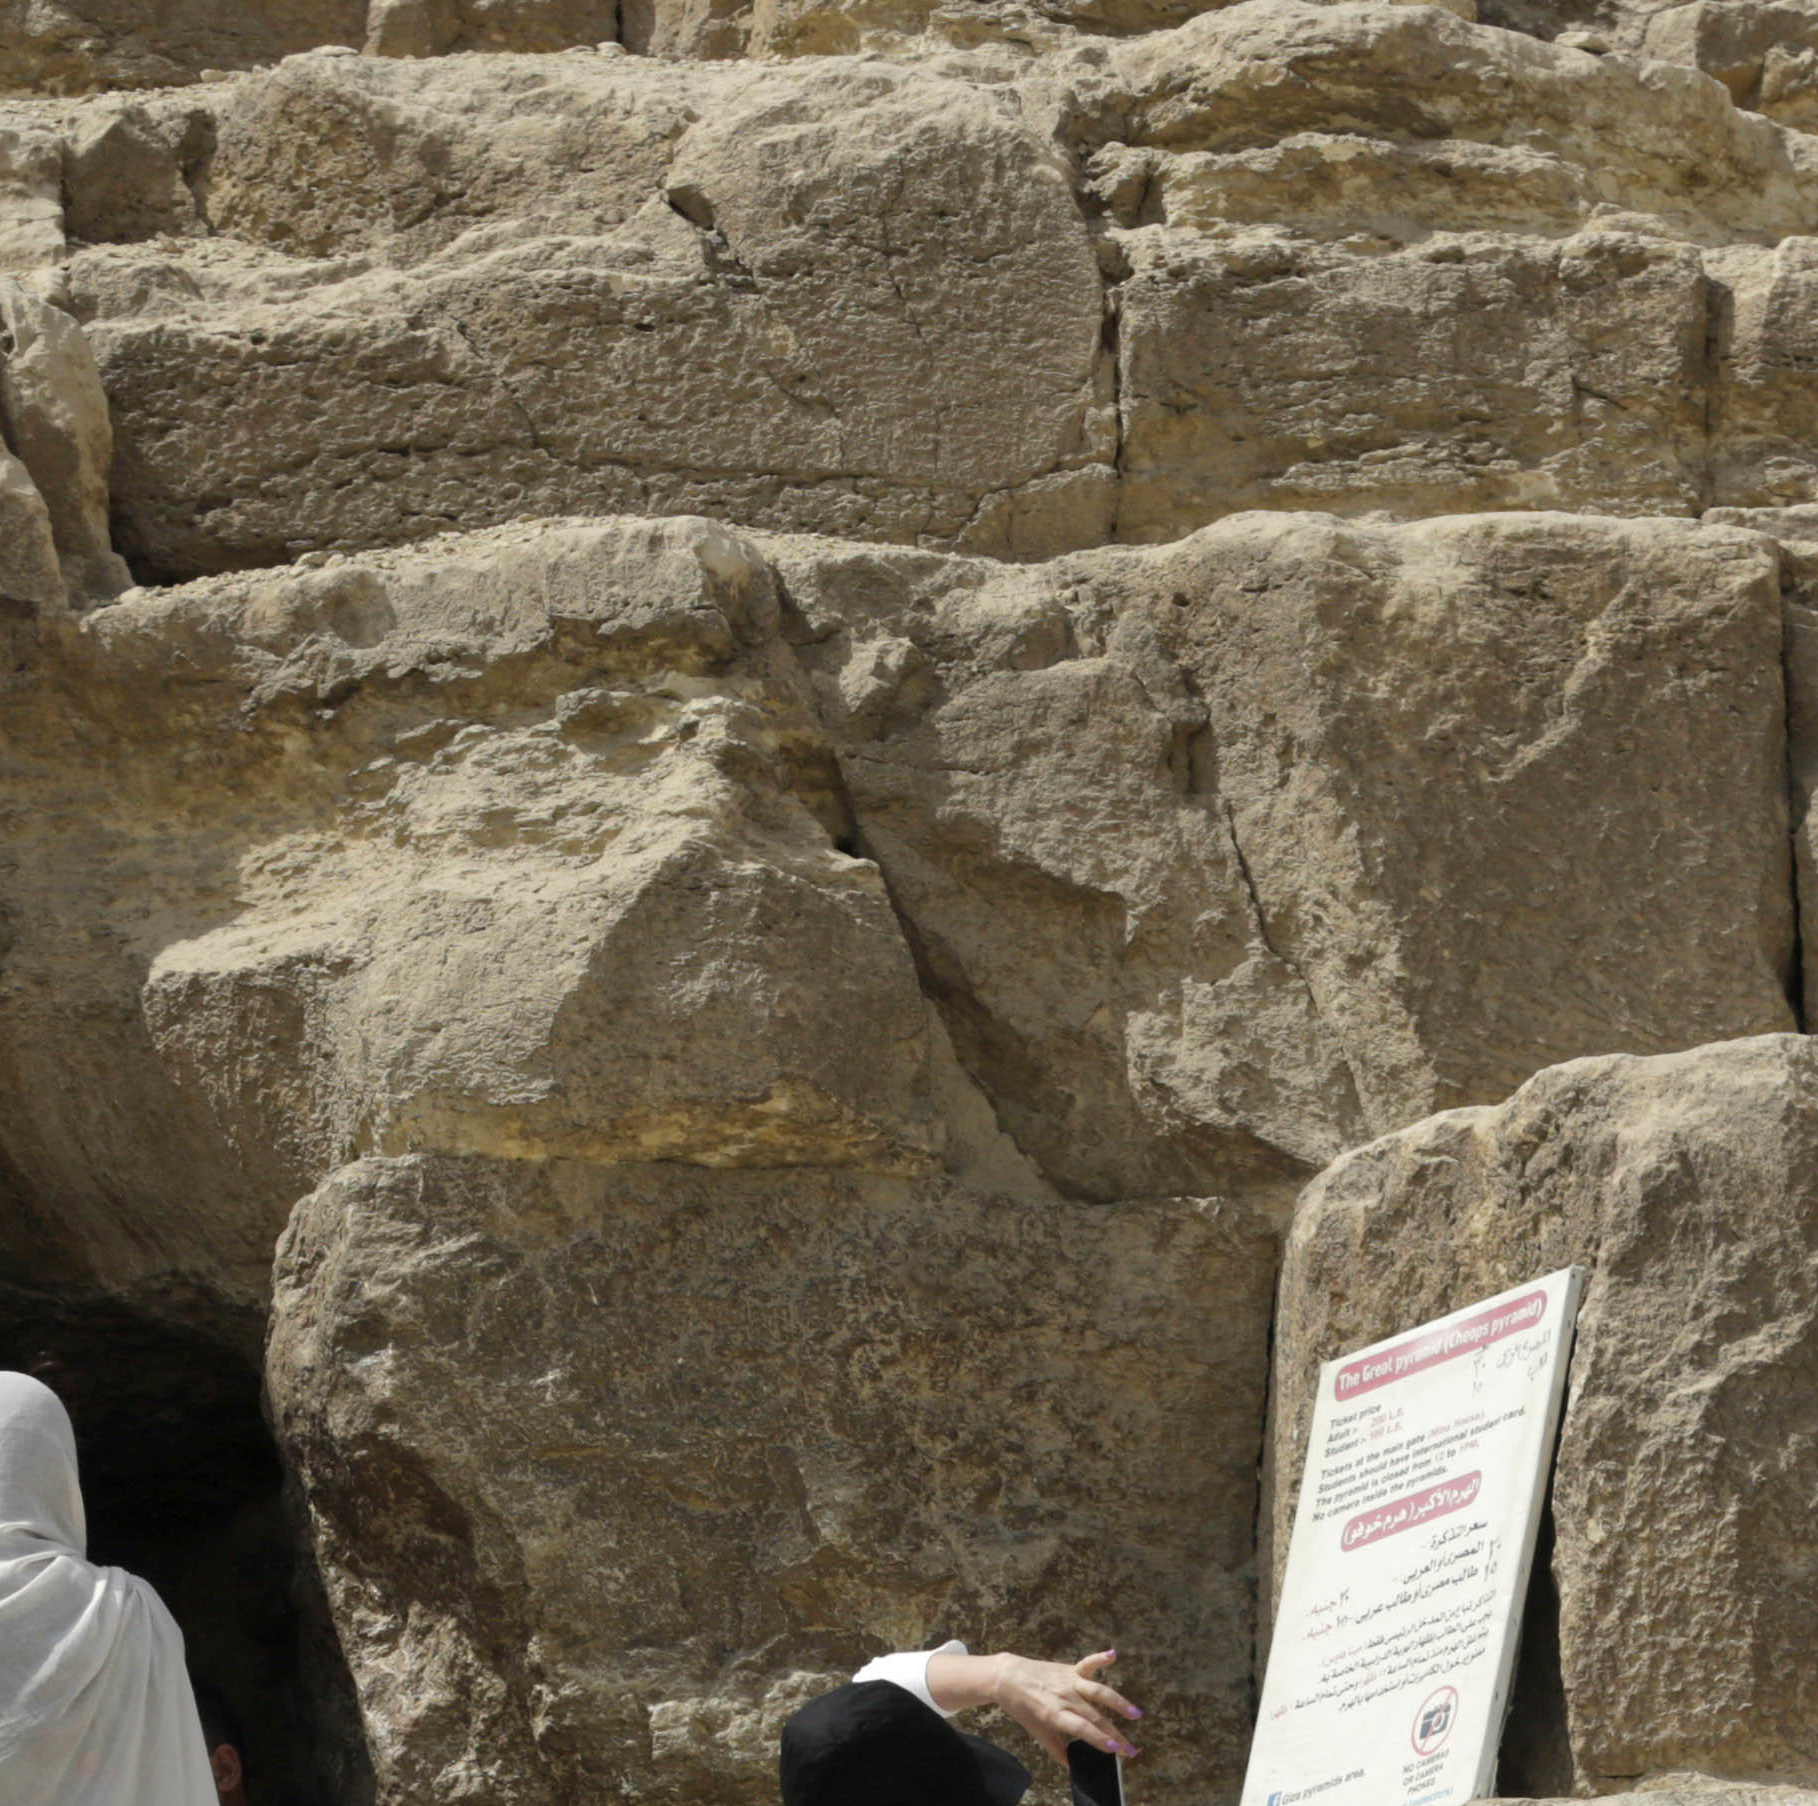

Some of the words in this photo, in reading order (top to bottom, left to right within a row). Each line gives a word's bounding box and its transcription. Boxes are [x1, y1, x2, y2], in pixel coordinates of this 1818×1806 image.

[1339, 1372, 1360, 1390] The
[1362, 1356, 1393, 1381] Great
[1443, 1323, 1489, 1353] (Cheops
[1490, 1298, 1542, 1336] pyramid)
[1330, 1412, 1358, 1429] Ticket
[1358, 1404, 1382, 1421] price
[1318, 1474, 1356, 1494] Students
[1358, 1460, 1387, 1479] should
[1389, 1454, 1409, 1467] have
[1412, 1429, 1468, 1458] international
[1470, 1416, 1502, 1436] student
[1321, 1462, 1352, 1479] Tickets
[1355, 1456, 1364, 1467] at
[1366, 1452, 1380, 1463] the
[1382, 1443, 1403, 1456] main
[1405, 1434, 1425, 1450] gate
[1324, 1438, 1359, 1458] Student
[1312, 1512, 1325, 1522] No
[1327, 1499, 1360, 1517] camera
[1362, 1488, 1387, 1504] inside
[1390, 1482, 1404, 1493] the
[1405, 1465, 1448, 1490] pyramids.
[1316, 1497, 1332, 1508] The
[1333, 1480, 1369, 1504] pyramid
[1371, 1478, 1378, 1487] is
[1381, 1465, 1410, 1484] closed
[1411, 1458, 1431, 1472] from
[1446, 1449, 1456, 1458] to
[1281, 1792, 1301, 1806] Giza
[1302, 1776, 1343, 1800] pyramids
[1344, 1768, 1366, 1782] area.
